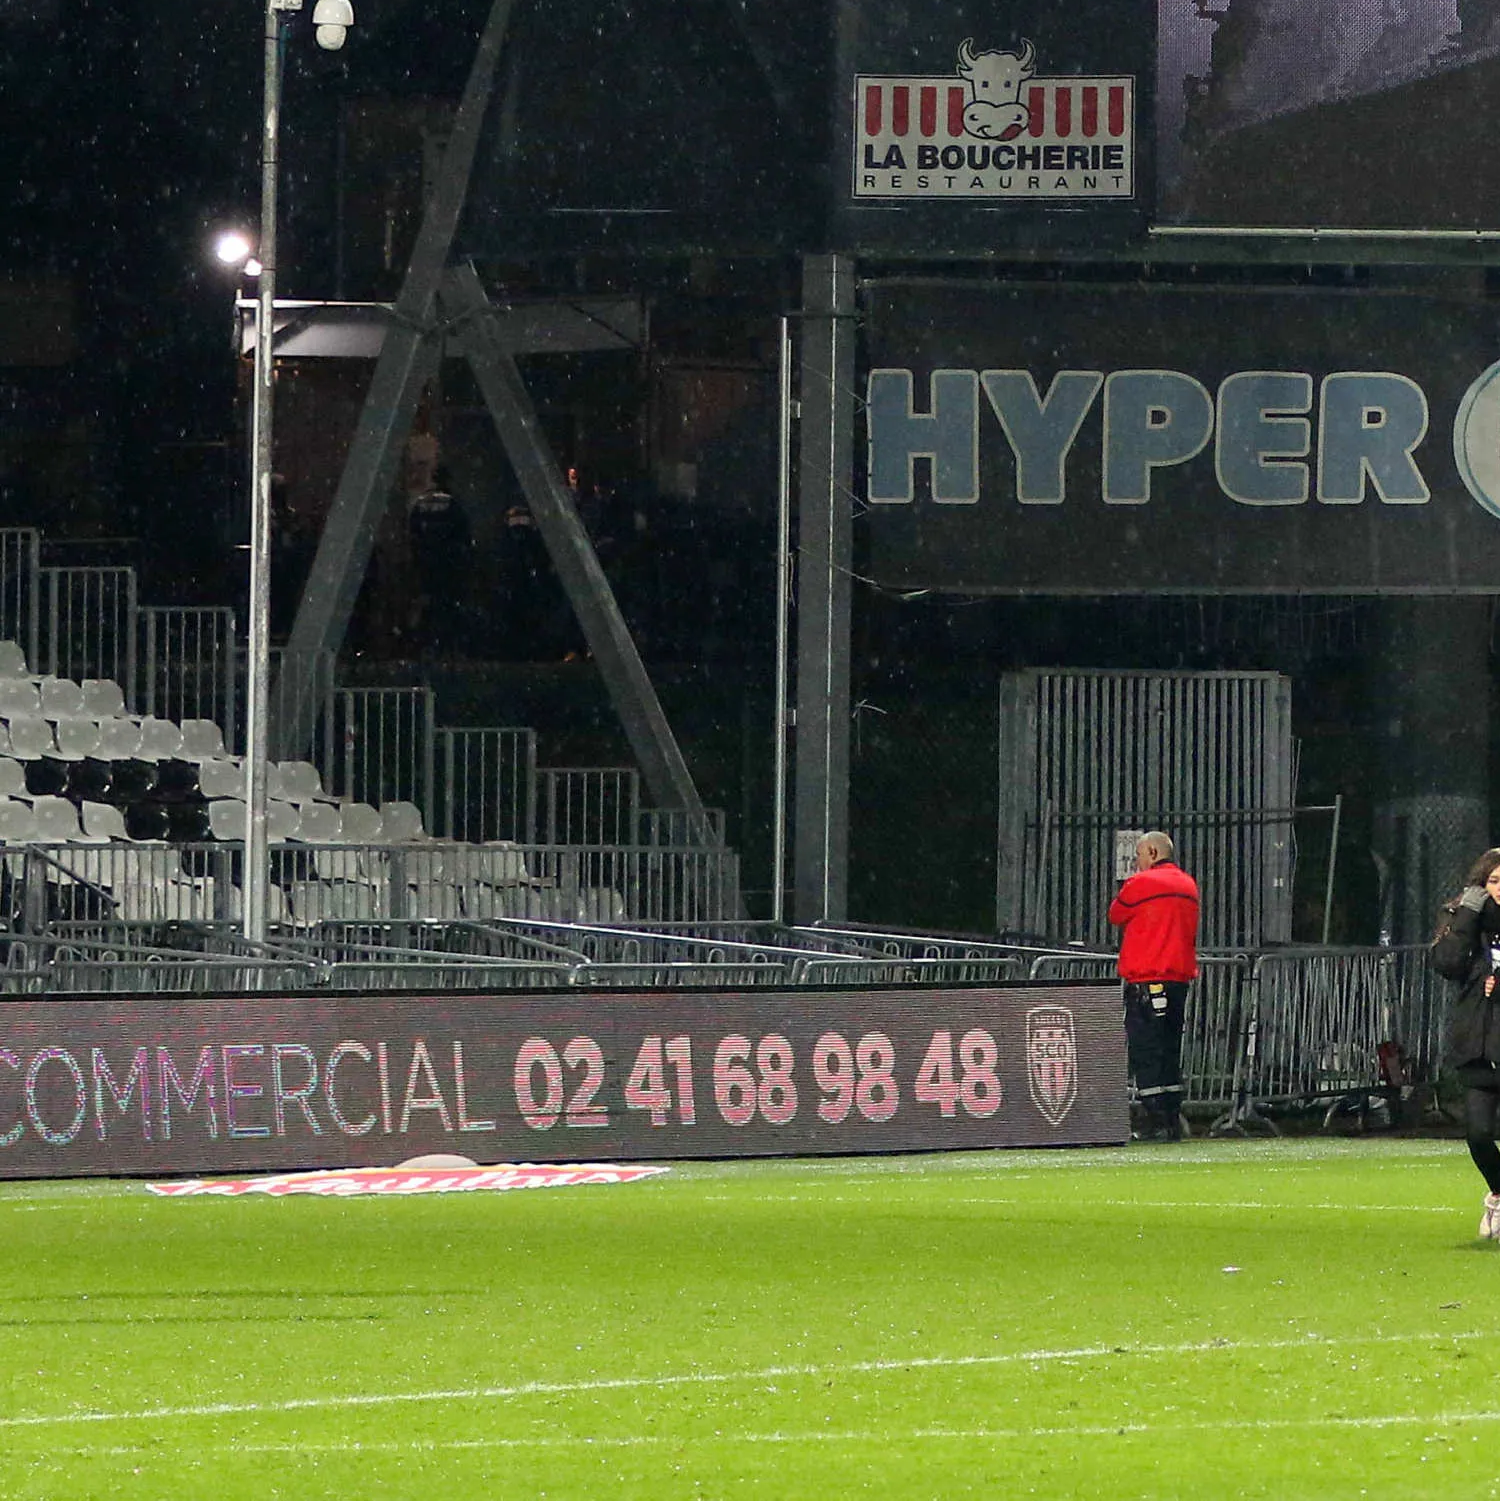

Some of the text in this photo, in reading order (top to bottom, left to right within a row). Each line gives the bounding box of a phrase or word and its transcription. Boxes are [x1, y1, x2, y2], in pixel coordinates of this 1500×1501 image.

[864, 144, 1124, 171] LA BOUCHERIE
[864, 175, 1123, 190] RESTAURANT
[866, 368, 1432, 506] HYPER
[513, 1035, 610, 1132] 02
[624, 1034, 698, 1127] 41
[713, 1032, 798, 1127] 68
[812, 1029, 898, 1125] 98
[913, 1027, 1001, 1119] 48
